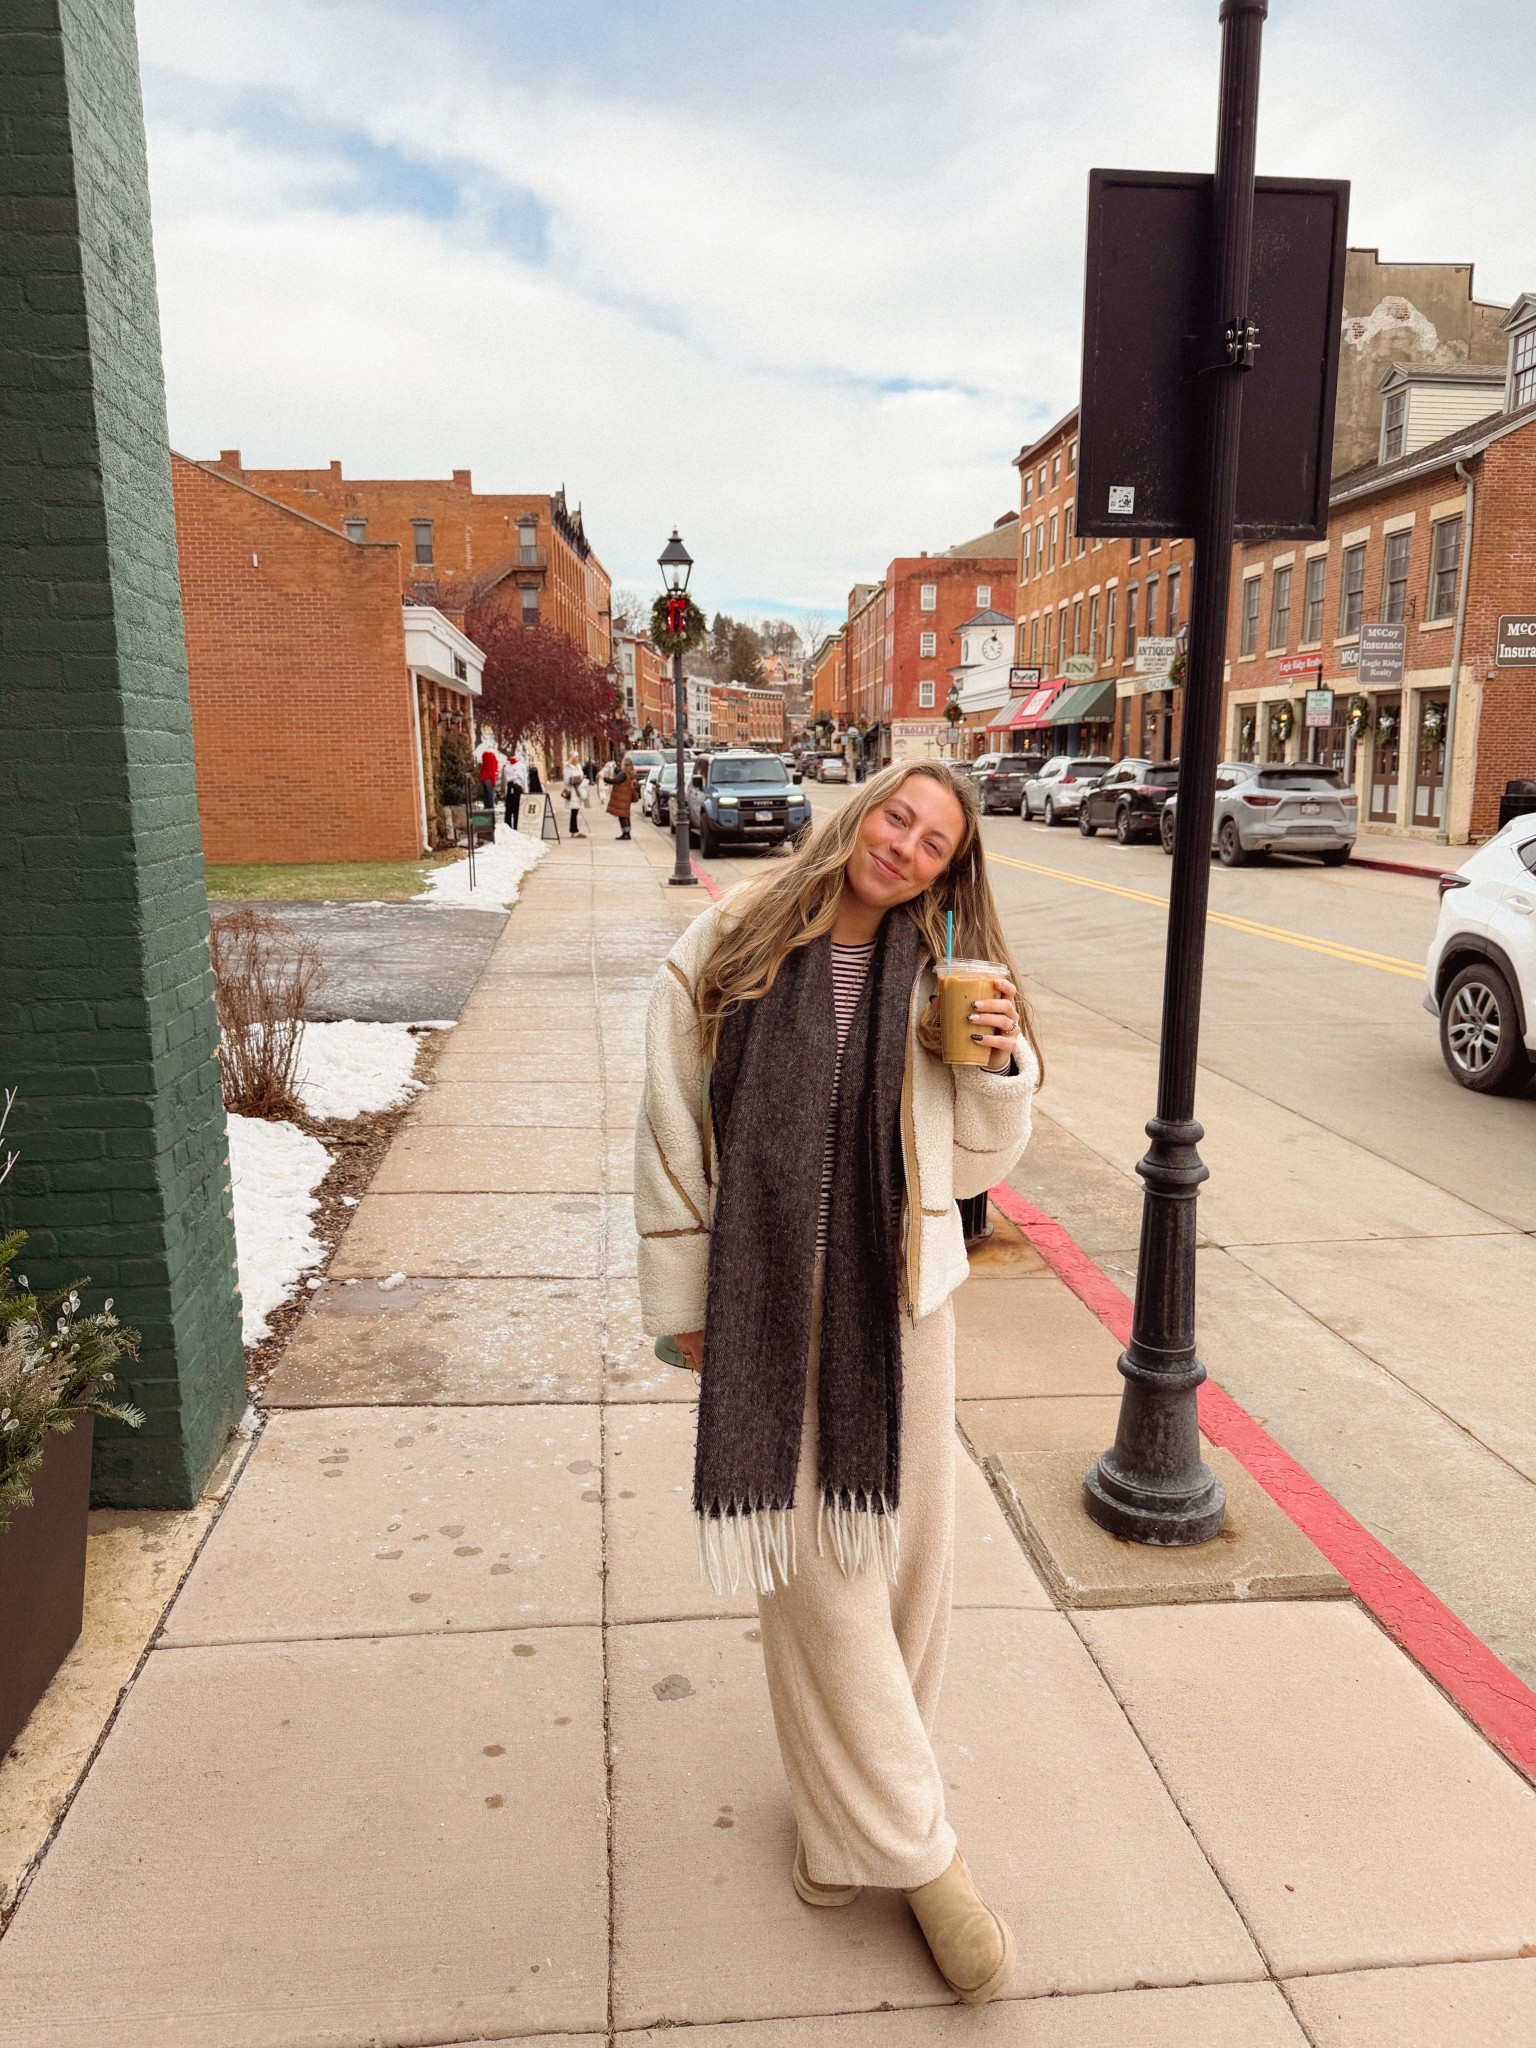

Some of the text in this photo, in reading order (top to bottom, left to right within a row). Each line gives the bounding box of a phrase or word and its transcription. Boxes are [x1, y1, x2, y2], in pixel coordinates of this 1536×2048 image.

[1368, 628, 1400, 639] McCoy
[1362, 640, 1404, 650] Insurance
[1137, 646, 1175, 656] ANTIQUES
[1065, 662, 1096, 673] INN
[1361, 659, 1403, 668] Eagle Ridge
[1370, 668, 1393, 677] Realty
[898, 726, 937, 735] TROLLEY
[528, 804, 537, 814] H
